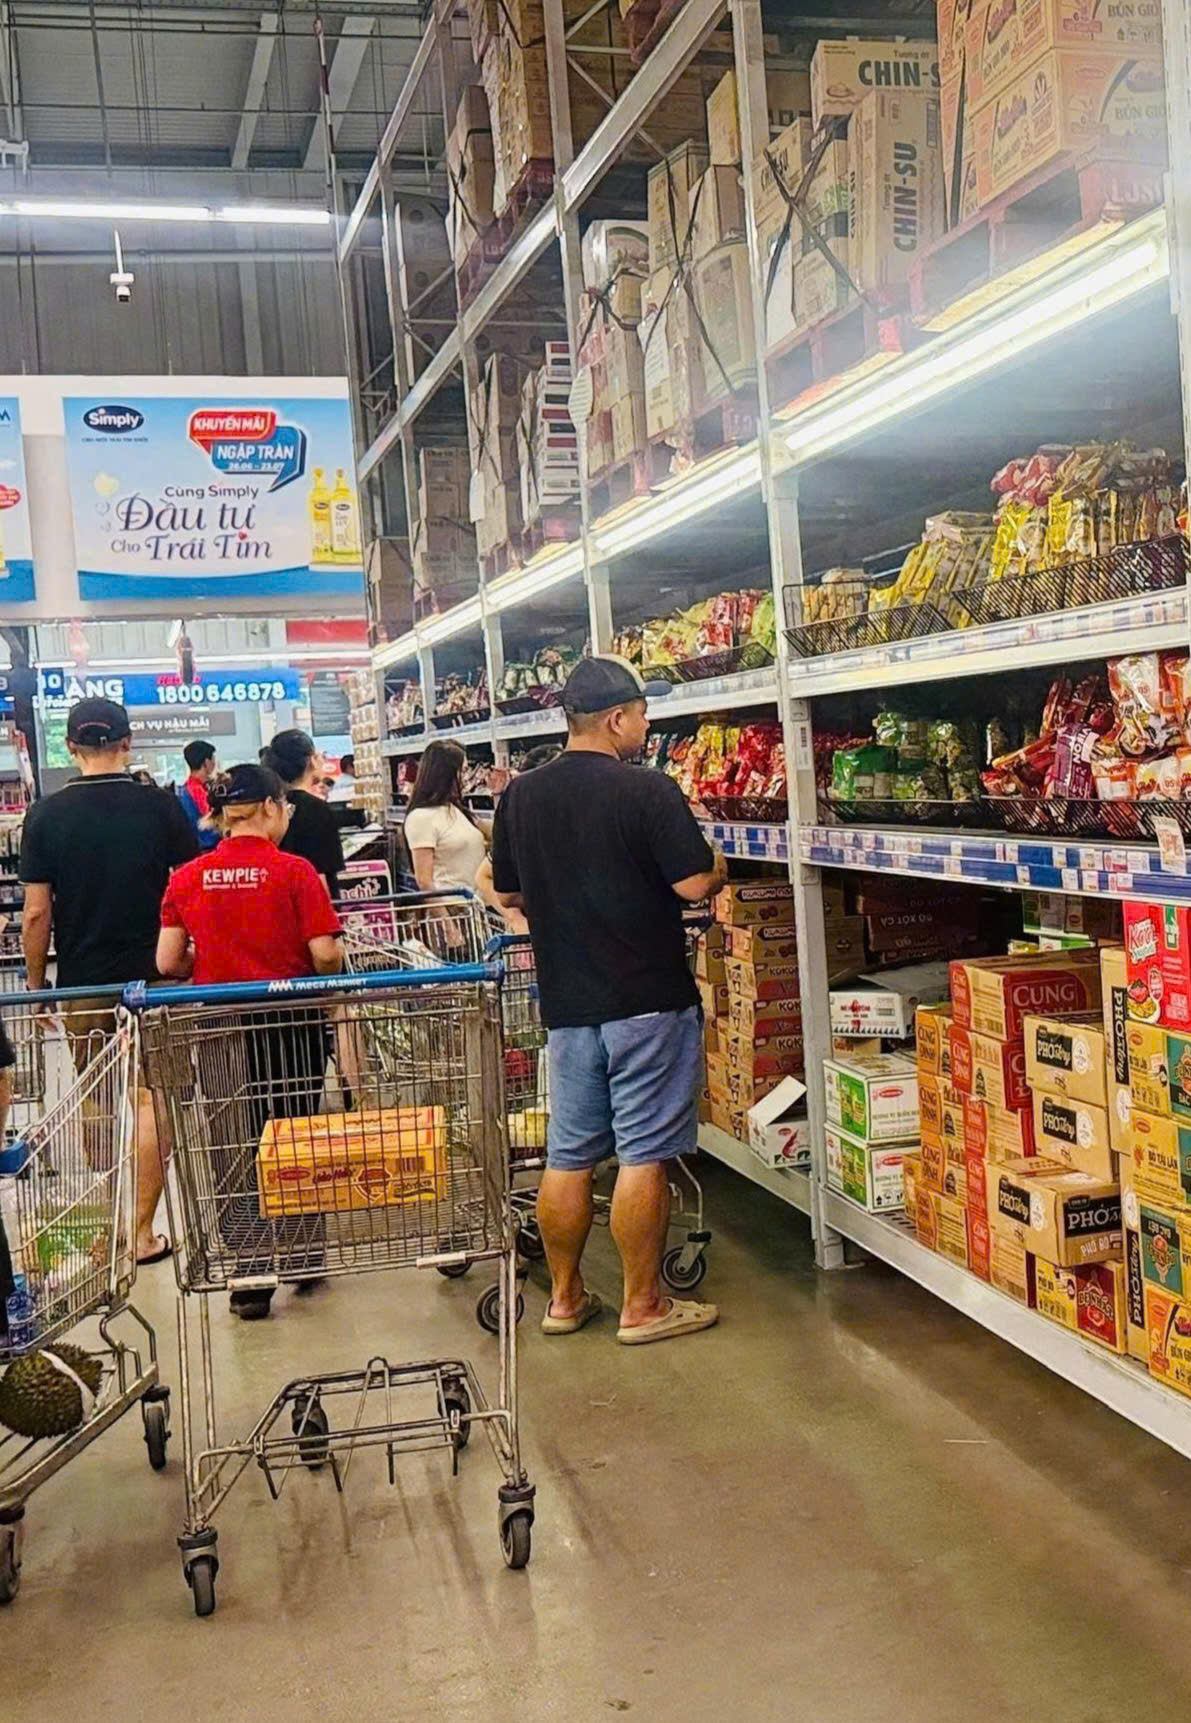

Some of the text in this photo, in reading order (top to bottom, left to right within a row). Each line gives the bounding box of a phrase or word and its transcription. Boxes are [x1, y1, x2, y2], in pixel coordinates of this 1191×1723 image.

[859, 60, 940, 87] CHIN-S
[894, 142, 917, 251] CHIN-SU
[89, 408, 140, 428] Simply
[193, 414, 242, 431] KHUYẾN
[217, 444, 294, 461] NGẬP TRÀN
[165, 485, 259, 499] Cùng Simply
[116, 493, 256, 532] Đầu tư
[112, 531, 272, 560] Cho Trái Tim
[157, 682, 285, 703] 1800 646878
[1072, 727, 1092, 763] VIFON
[203, 868, 259, 884] KEWPIE
[1013, 983, 1075, 1007] CUNG
[1068, 1203, 1109, 1229] PHỞ
